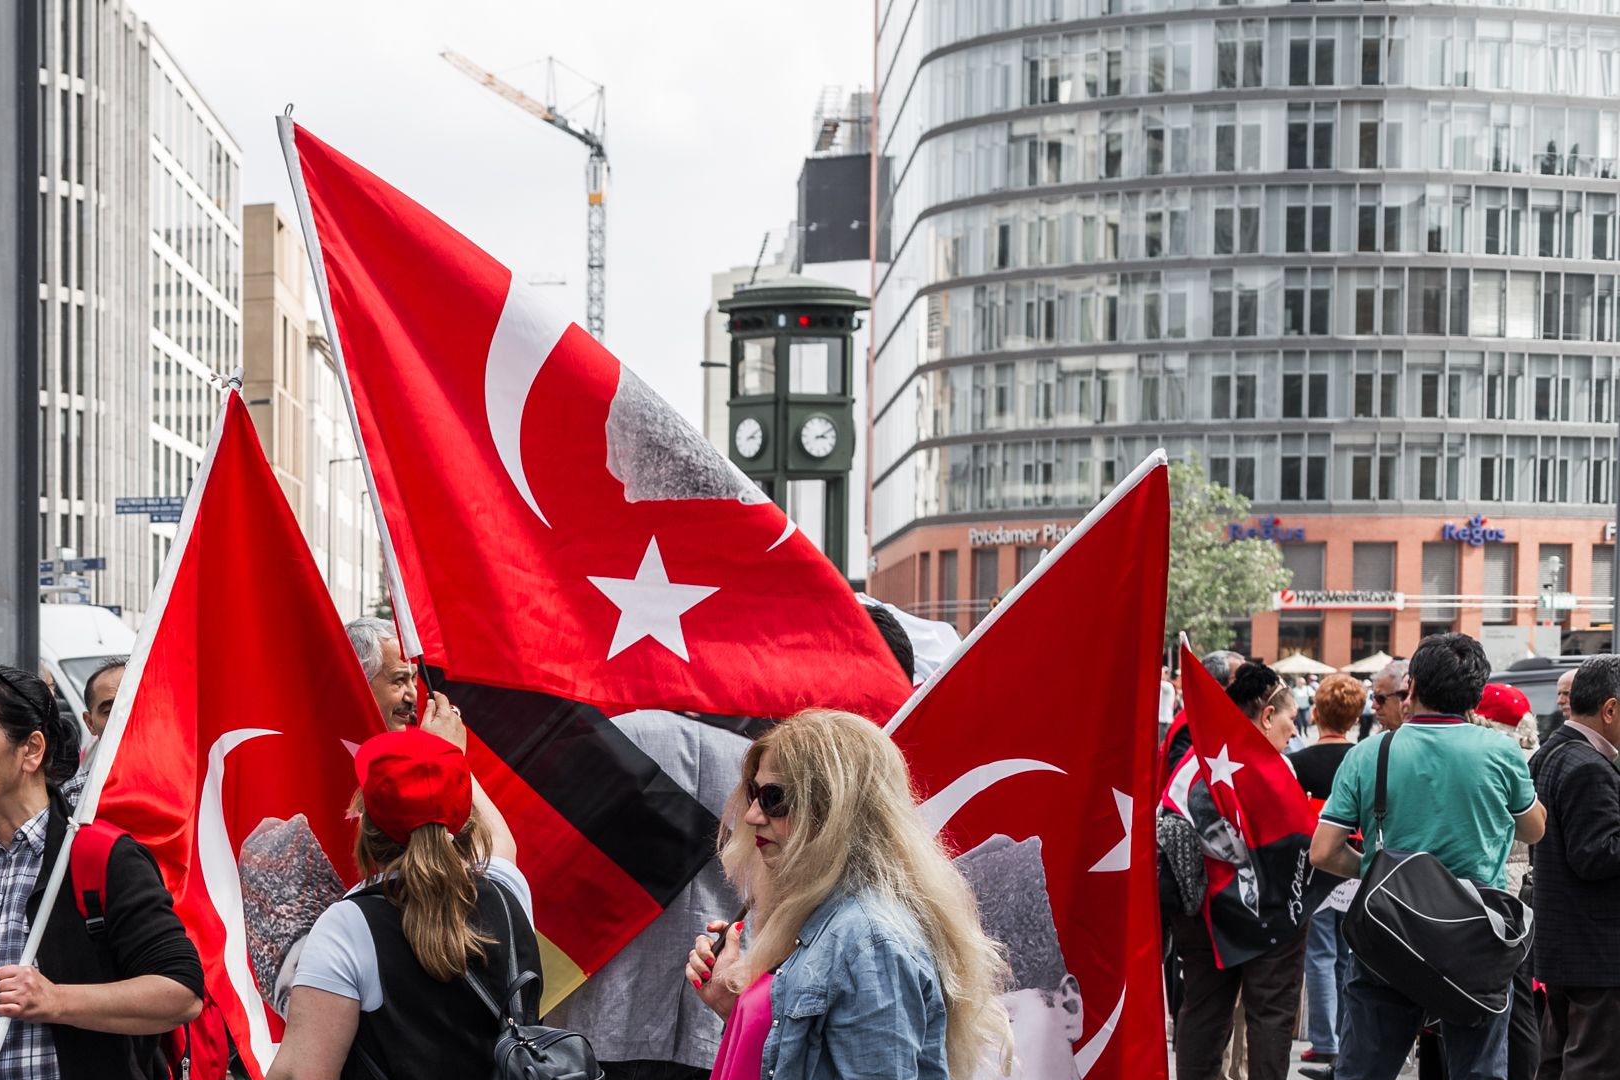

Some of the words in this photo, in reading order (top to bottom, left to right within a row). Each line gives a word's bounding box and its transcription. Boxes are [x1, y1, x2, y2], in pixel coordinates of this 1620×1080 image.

[968, 526, 1039, 545] Potsdamer
[1042, 523, 1074, 543] Plat
[1443, 522, 1506, 546] Regus
[1296, 590, 1396, 606] HypoVereinsbank
